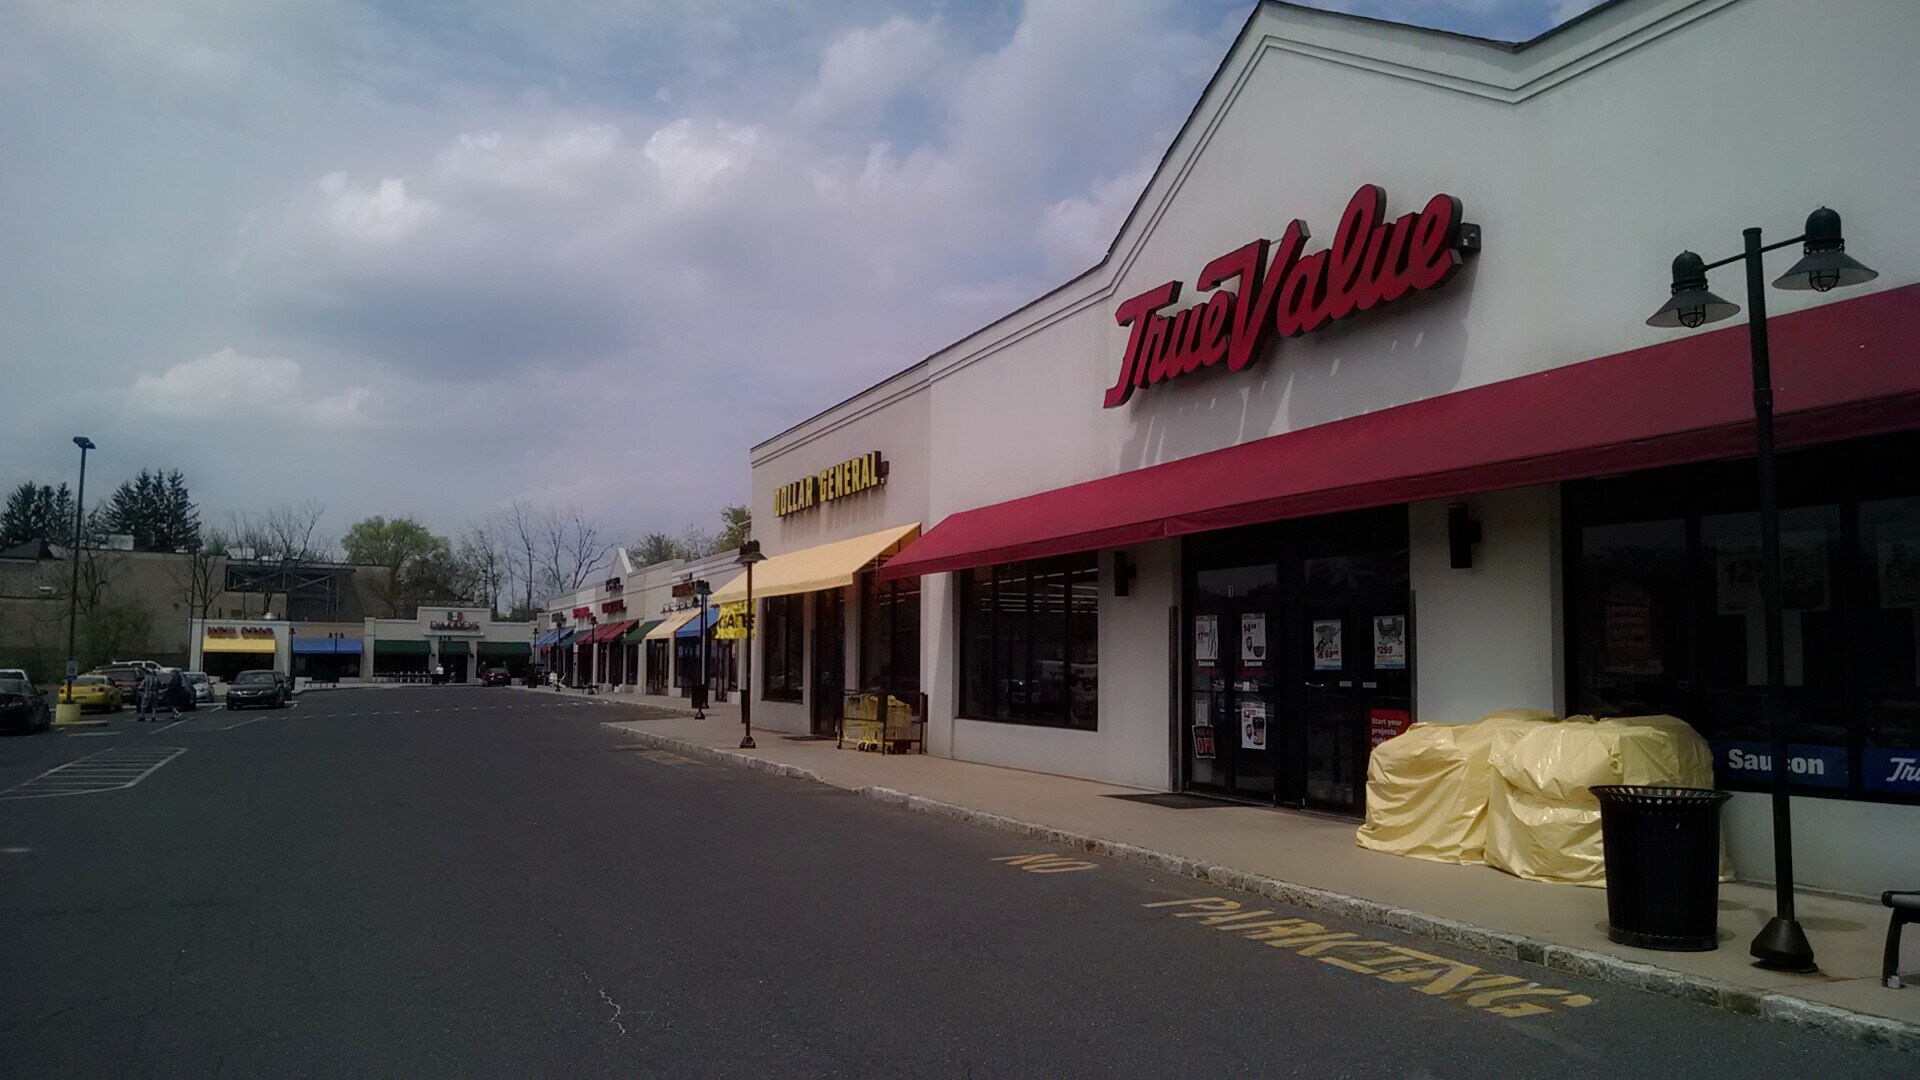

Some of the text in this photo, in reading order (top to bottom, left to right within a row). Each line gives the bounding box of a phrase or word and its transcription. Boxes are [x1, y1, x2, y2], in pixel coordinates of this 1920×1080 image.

[773, 450, 882, 518] DOLLAR GENERAL
[1371, 717, 1402, 727] Start your
[1371, 728, 1397, 736] projects
[1728, 748, 1825, 775] Sauon
[991, 853, 1099, 874] NO
[1142, 896, 1592, 1019] PARKING
